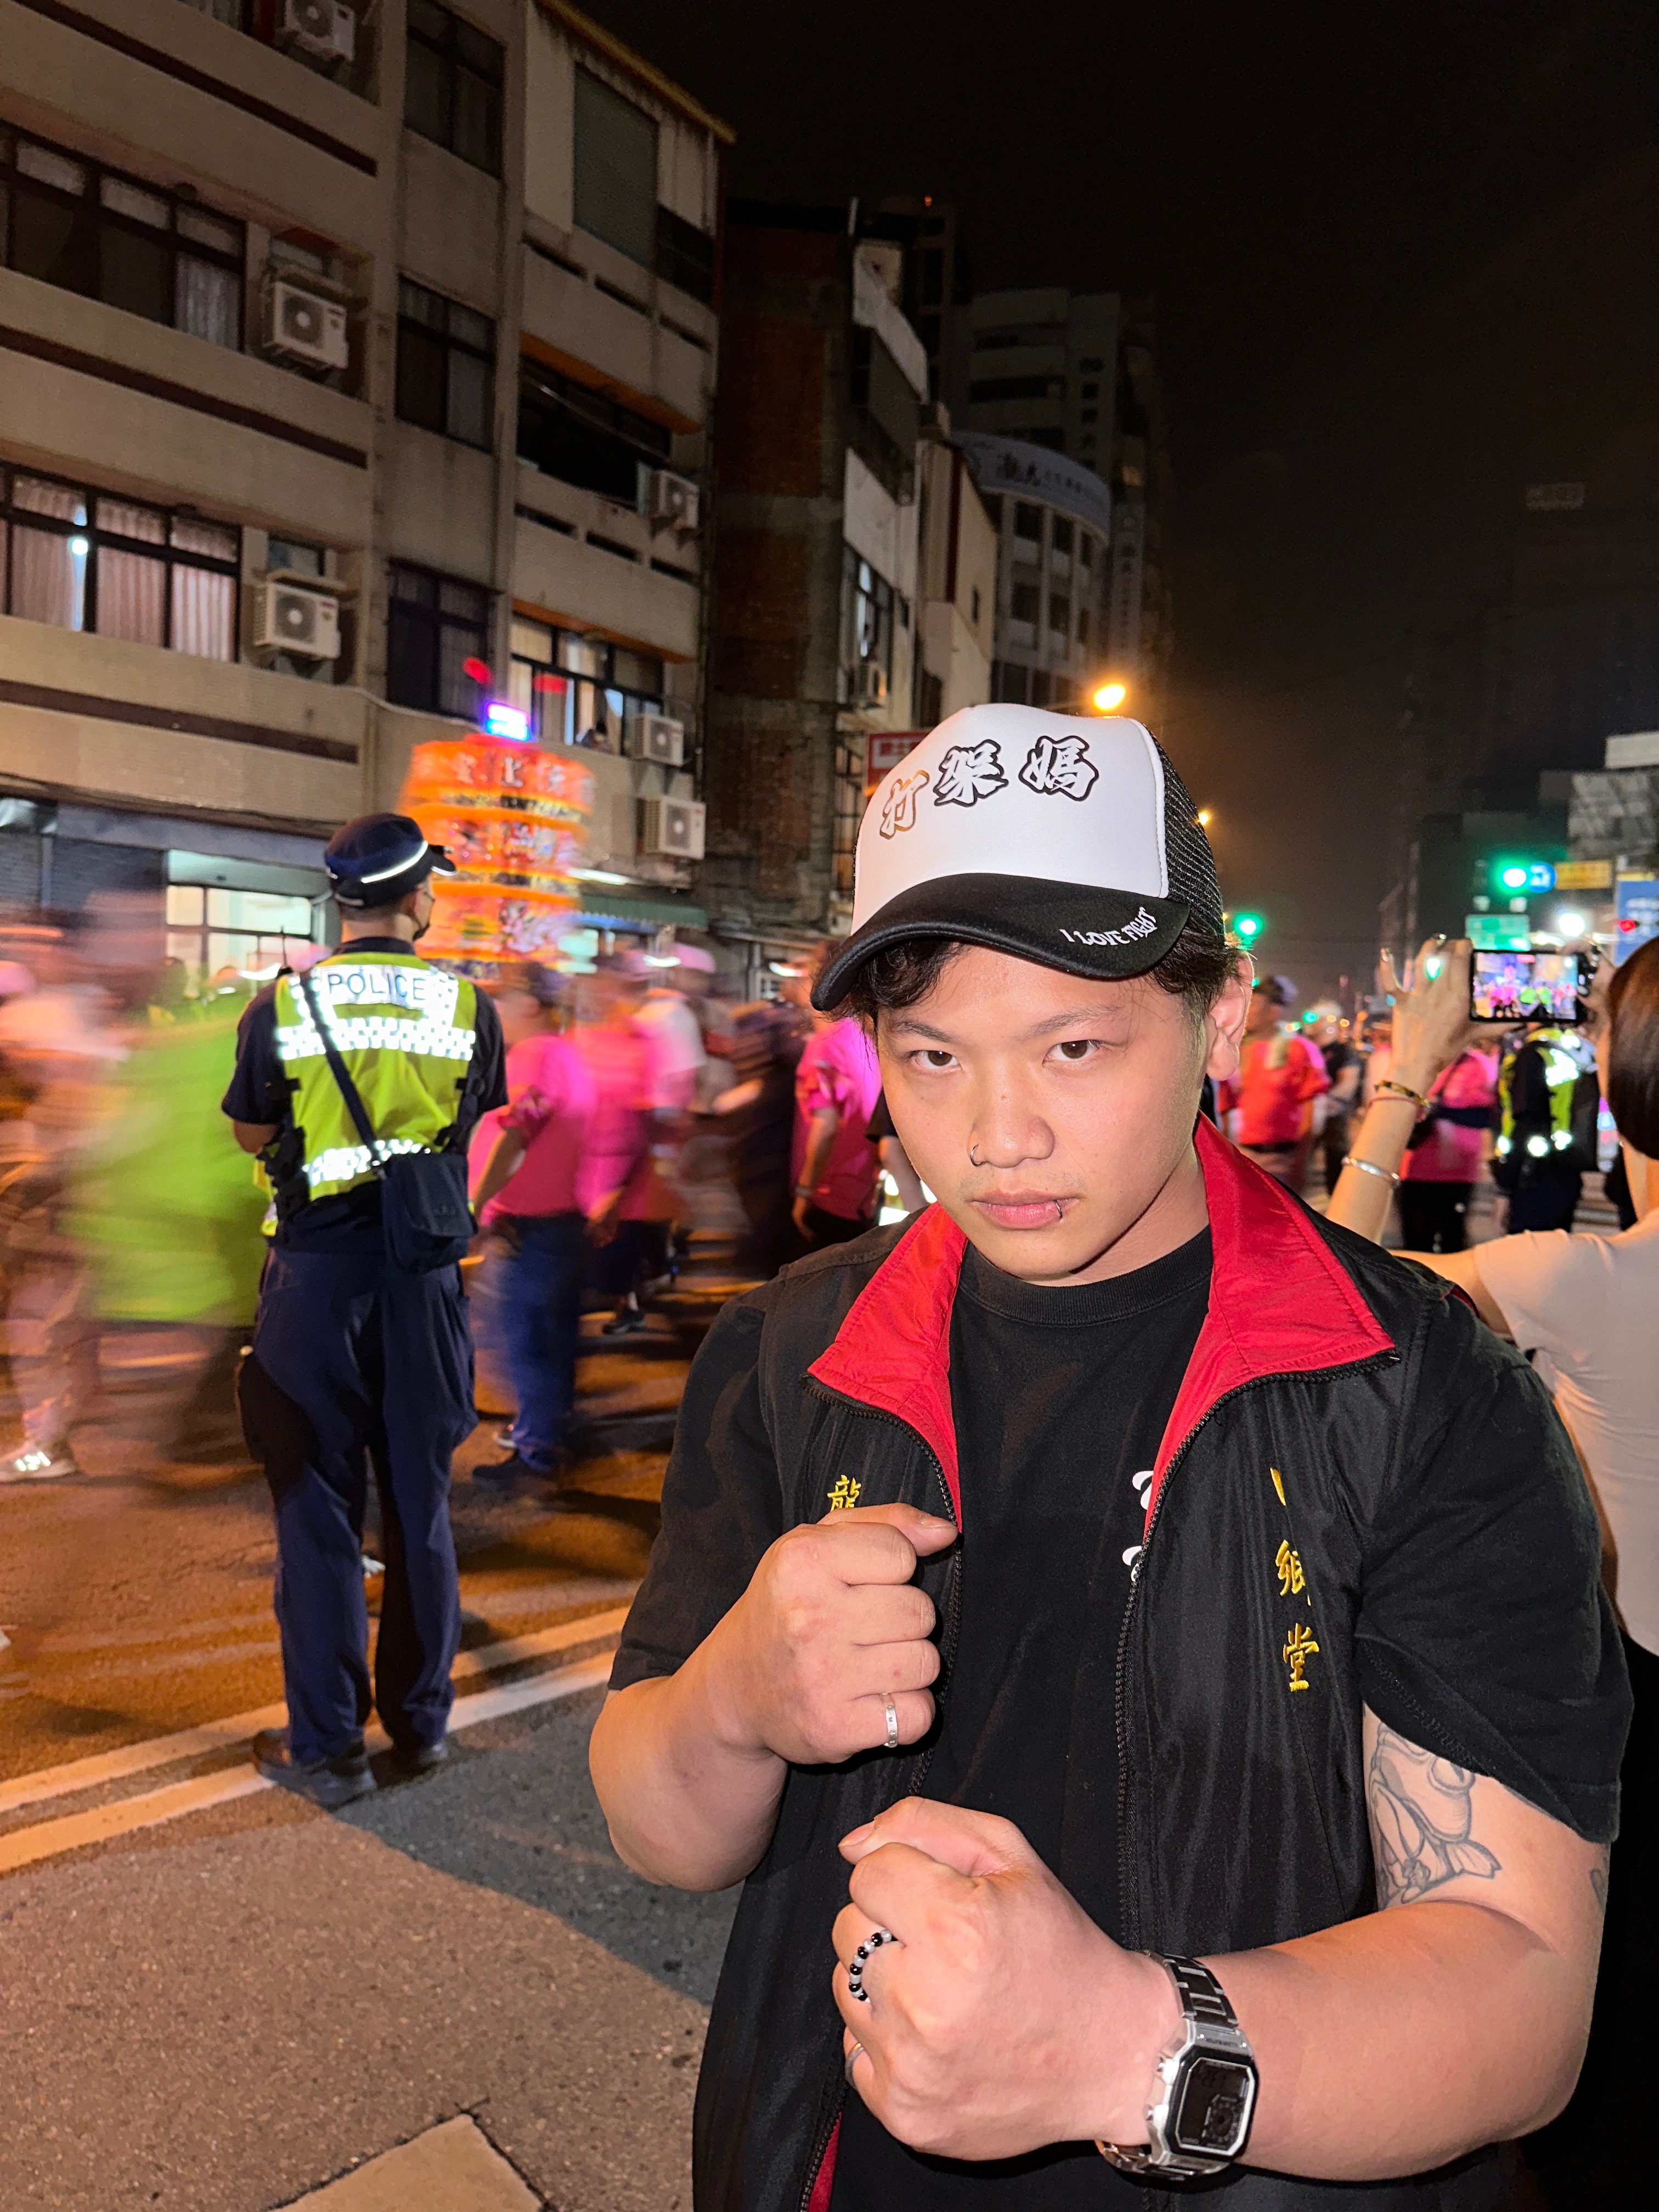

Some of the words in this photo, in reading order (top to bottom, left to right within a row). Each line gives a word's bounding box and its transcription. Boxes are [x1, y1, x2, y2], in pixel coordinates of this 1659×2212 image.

[1059, 929, 1075, 943] I
[1074, 930, 1130, 946] LOVE
[1121, 906, 1158, 941] FIGHT
[328, 973, 426, 1000] POLICE
